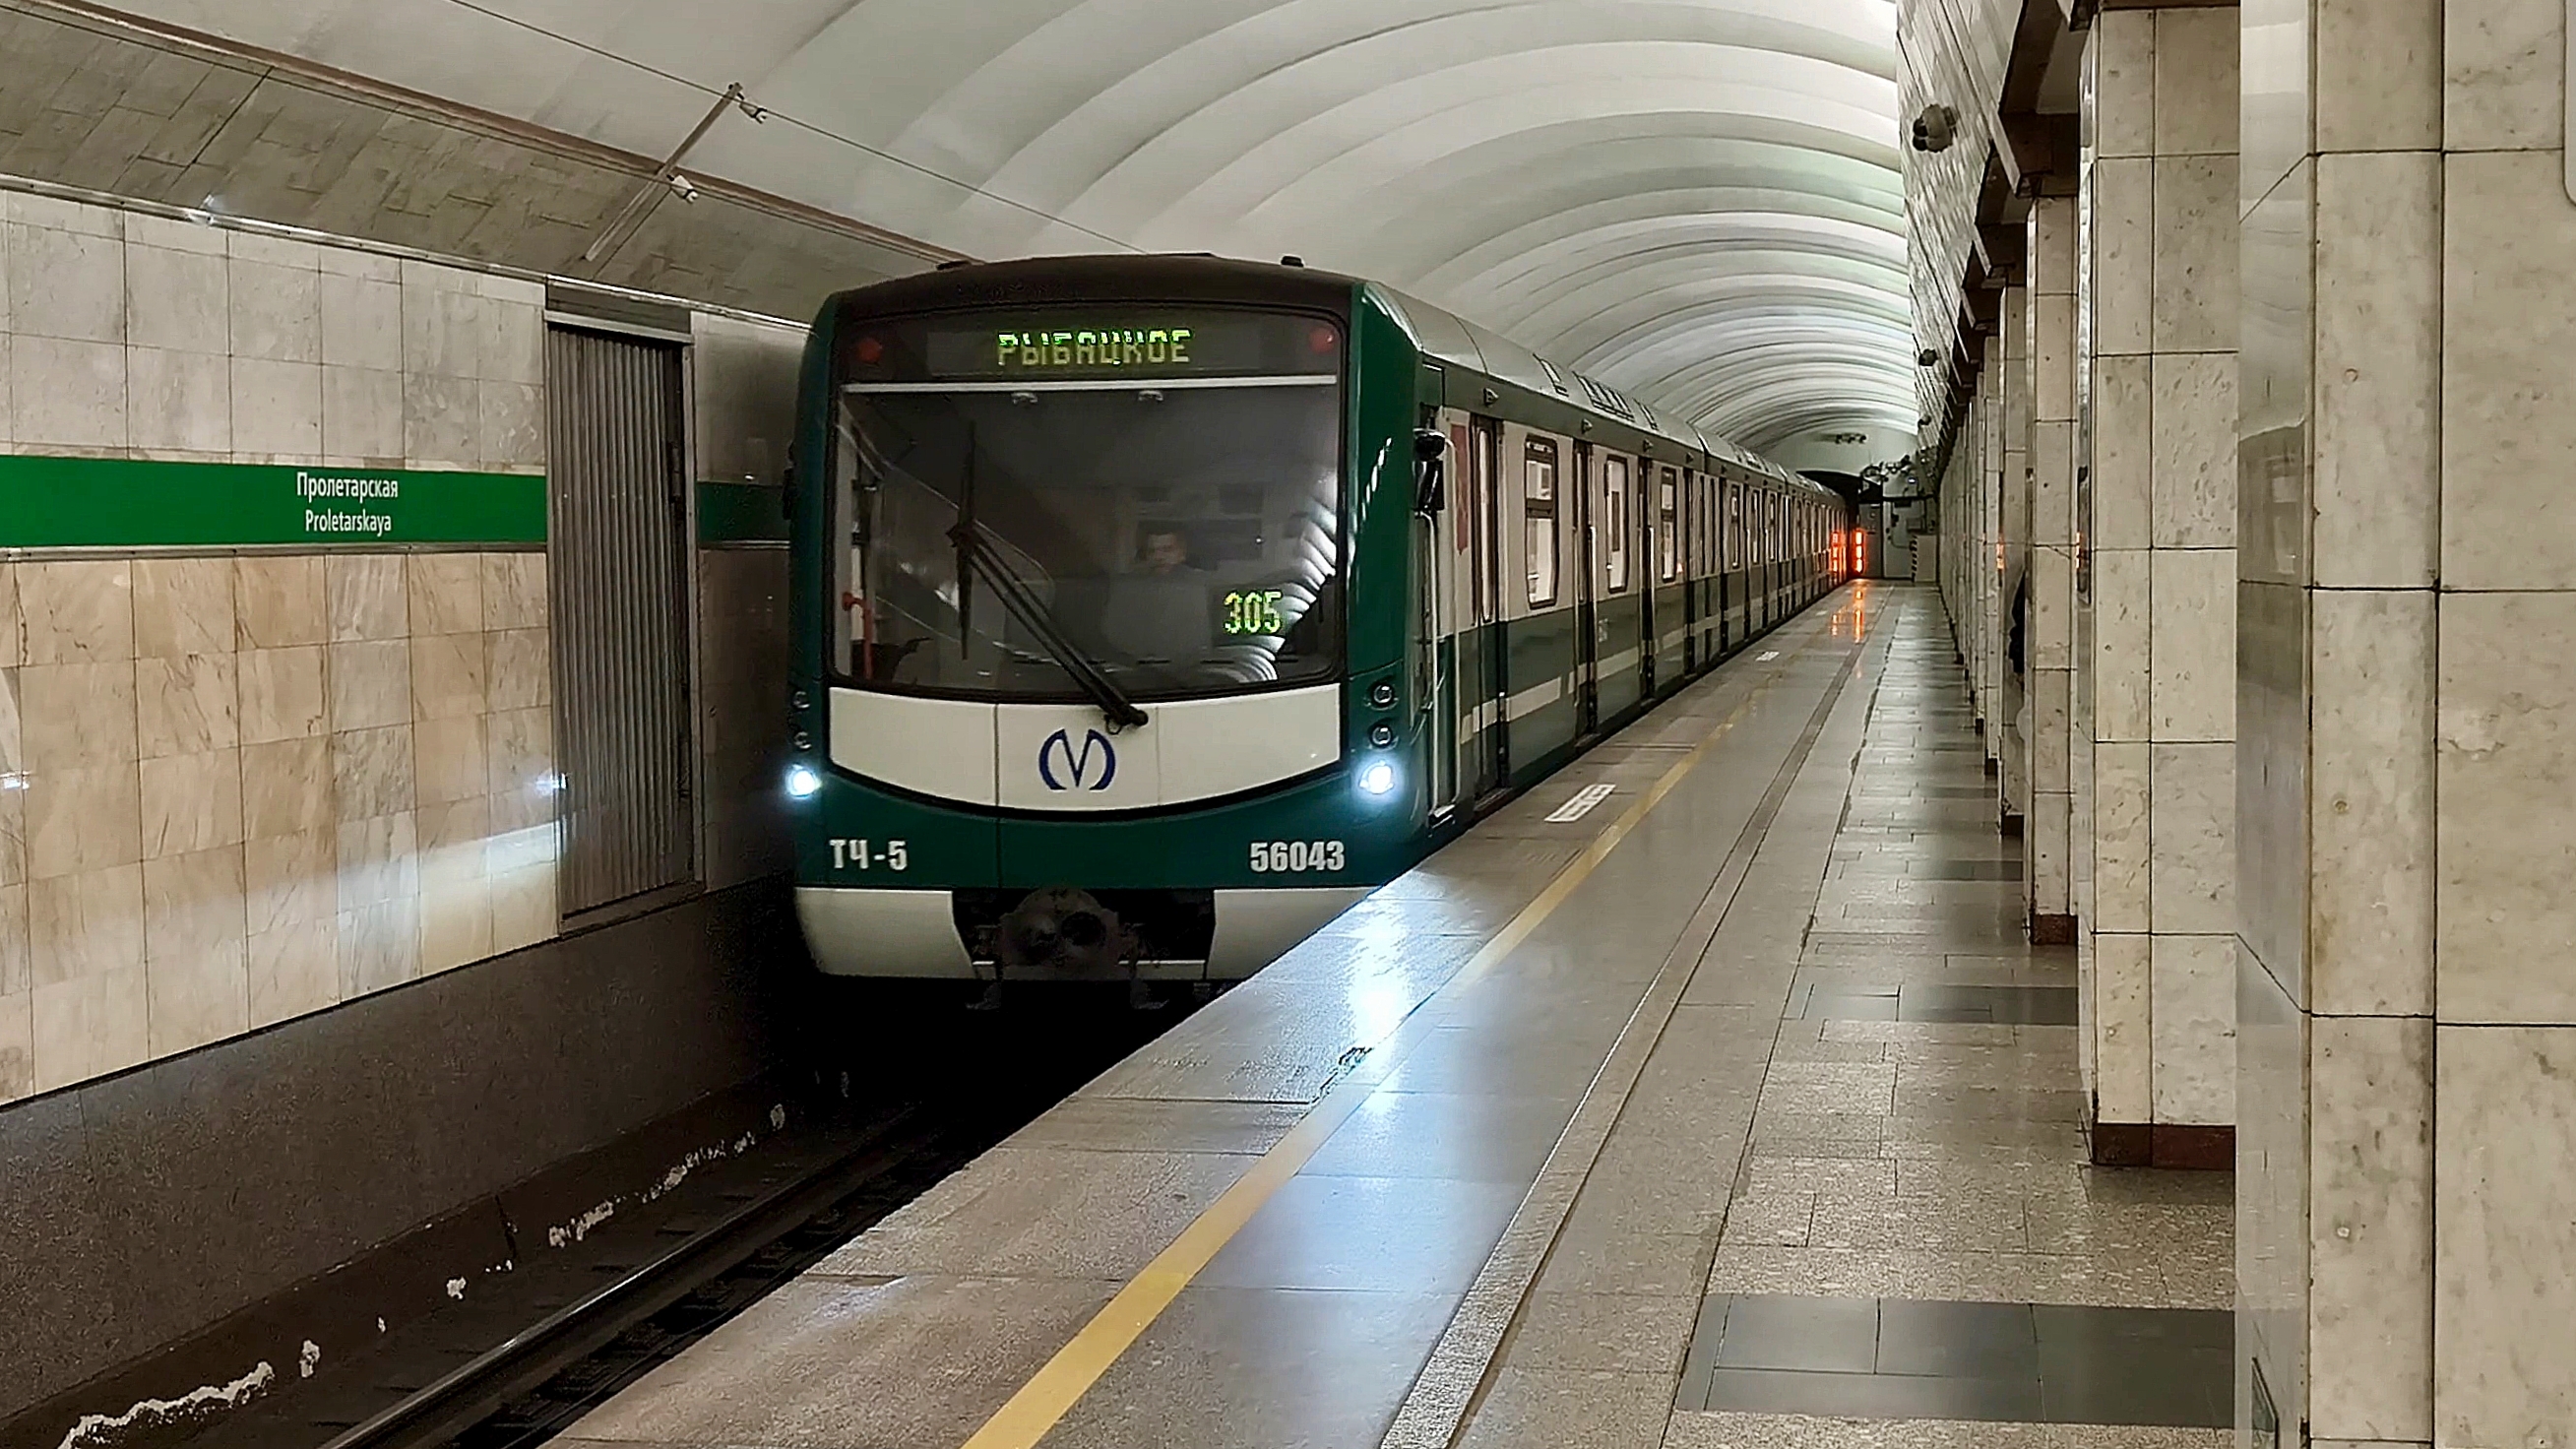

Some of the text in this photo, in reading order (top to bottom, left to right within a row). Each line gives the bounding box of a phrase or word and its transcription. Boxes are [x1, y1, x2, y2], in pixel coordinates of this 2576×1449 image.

[997, 330, 1191, 366] РЫБАЦКОЕ
[296, 472, 399, 504] Пролетарская
[305, 508, 392, 537] Proletarskaya
[1225, 591, 1283, 634] 305
[1250, 840, 1346, 872] 56043
